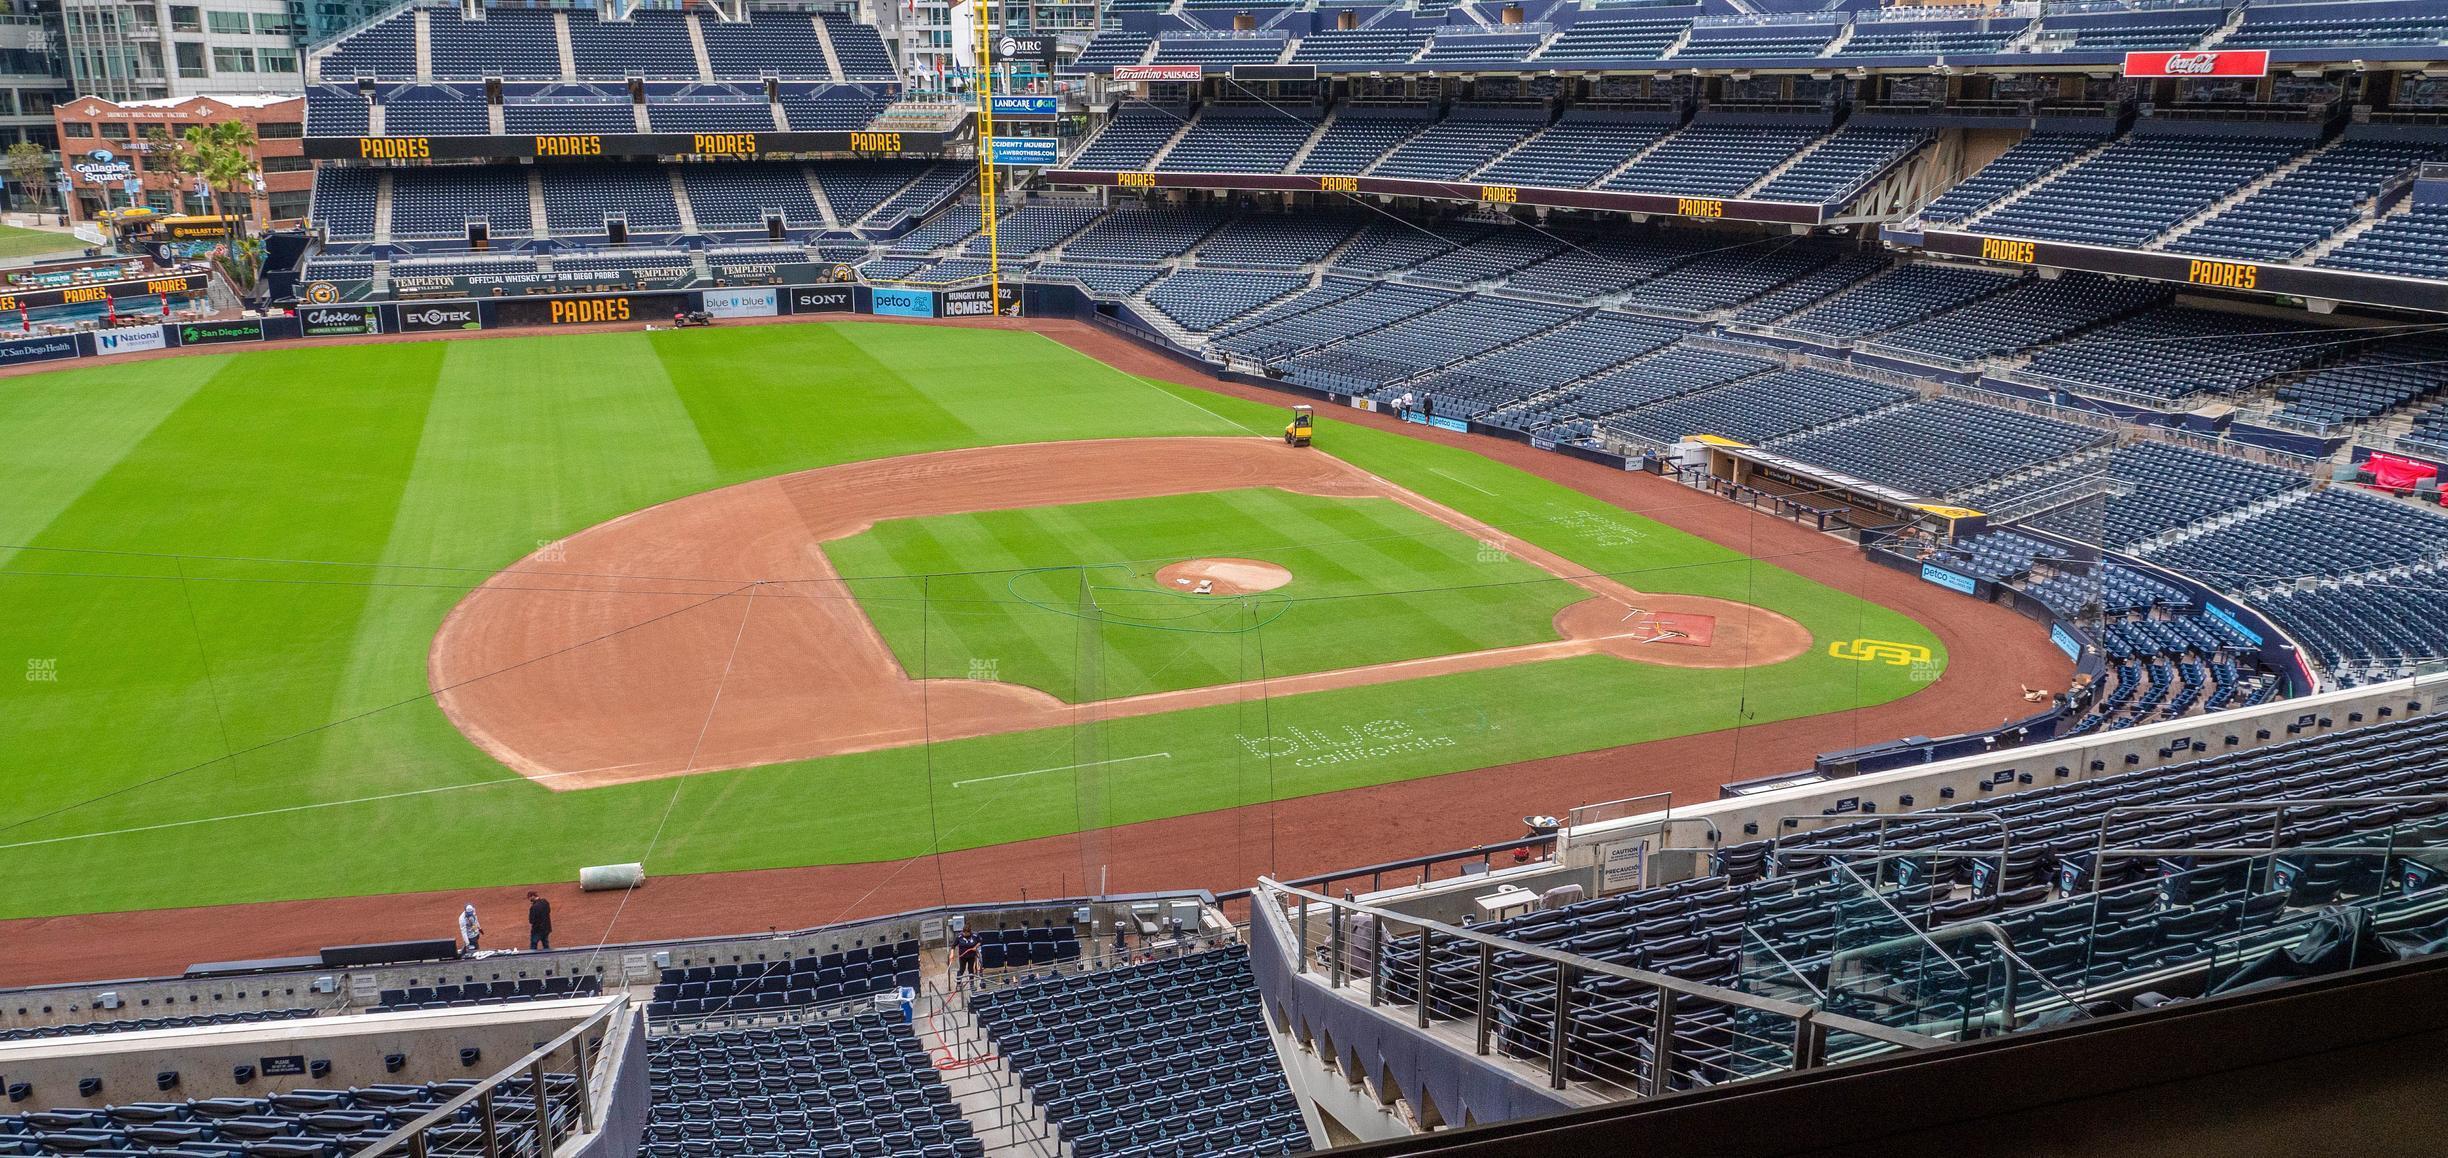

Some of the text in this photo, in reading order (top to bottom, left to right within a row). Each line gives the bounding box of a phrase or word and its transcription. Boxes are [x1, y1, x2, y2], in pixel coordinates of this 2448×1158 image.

[1017, 41, 1042, 50] MRC
[2165, 53, 2218, 74] Coca-Cola
[1116, 67, 1199, 79] Tarantino SAUSAGES
[994, 100, 1055, 108] LANDCARE LOGIC
[360, 137, 430, 159] PADRES
[536, 136, 601, 156] PADRES
[694, 134, 756, 153] PADRES
[851, 132, 901, 151] PADRES
[75, 163, 130, 174] Gallagher
[85, 172, 123, 183] Square
[1118, 172, 1156, 187] PADRES
[1321, 176, 1358, 192] PADRES
[1482, 186, 1517, 203] PADRES
[1678, 198, 1722, 217] PADRES
[1983, 238, 2036, 263] PADRES
[632, 268, 688, 278] TEMPLETON
[722, 265, 776, 275] TEMPLETON
[2189, 260, 2257, 289] PADRES
[394, 277, 454, 287] TEMPLETON
[469, 276, 504, 284] OFFICIAL
[505, 274, 540, 283] WHISKEY
[574, 272, 593, 280] DIEGO
[595, 271, 620, 279] PADRES
[148, 278, 188, 294] PADRES
[64, 287, 107, 303] PADRES
[742, 296, 764, 306] blue
[800, 294, 847, 305] SONY
[948, 291, 990, 300] HUNGRY FOR
[998, 289, 1011, 299] 322
[706, 298, 728, 308] blue
[876, 295, 911, 308] petco
[946, 300, 994, 316] HOMERS
[308, 310, 361, 324] Chosen
[407, 309, 472, 326] EVOTEK
[551, 297, 630, 324] PADRES
[120, 330, 160, 342] National
[217, 329, 240, 339] Diego
[241, 327, 260, 335] Zoo
[10, 347, 24, 356] San
[24, 345, 46, 357] Diego
[47, 342, 70, 353] Health
[1924, 567, 1948, 581] petco
[1235, 719, 1414, 759] blue
[1295, 735, 1456, 767] california
[1611, 847, 1638, 856] CAUTION
[1605, 864, 1639, 875] PRECAUCIÓ
